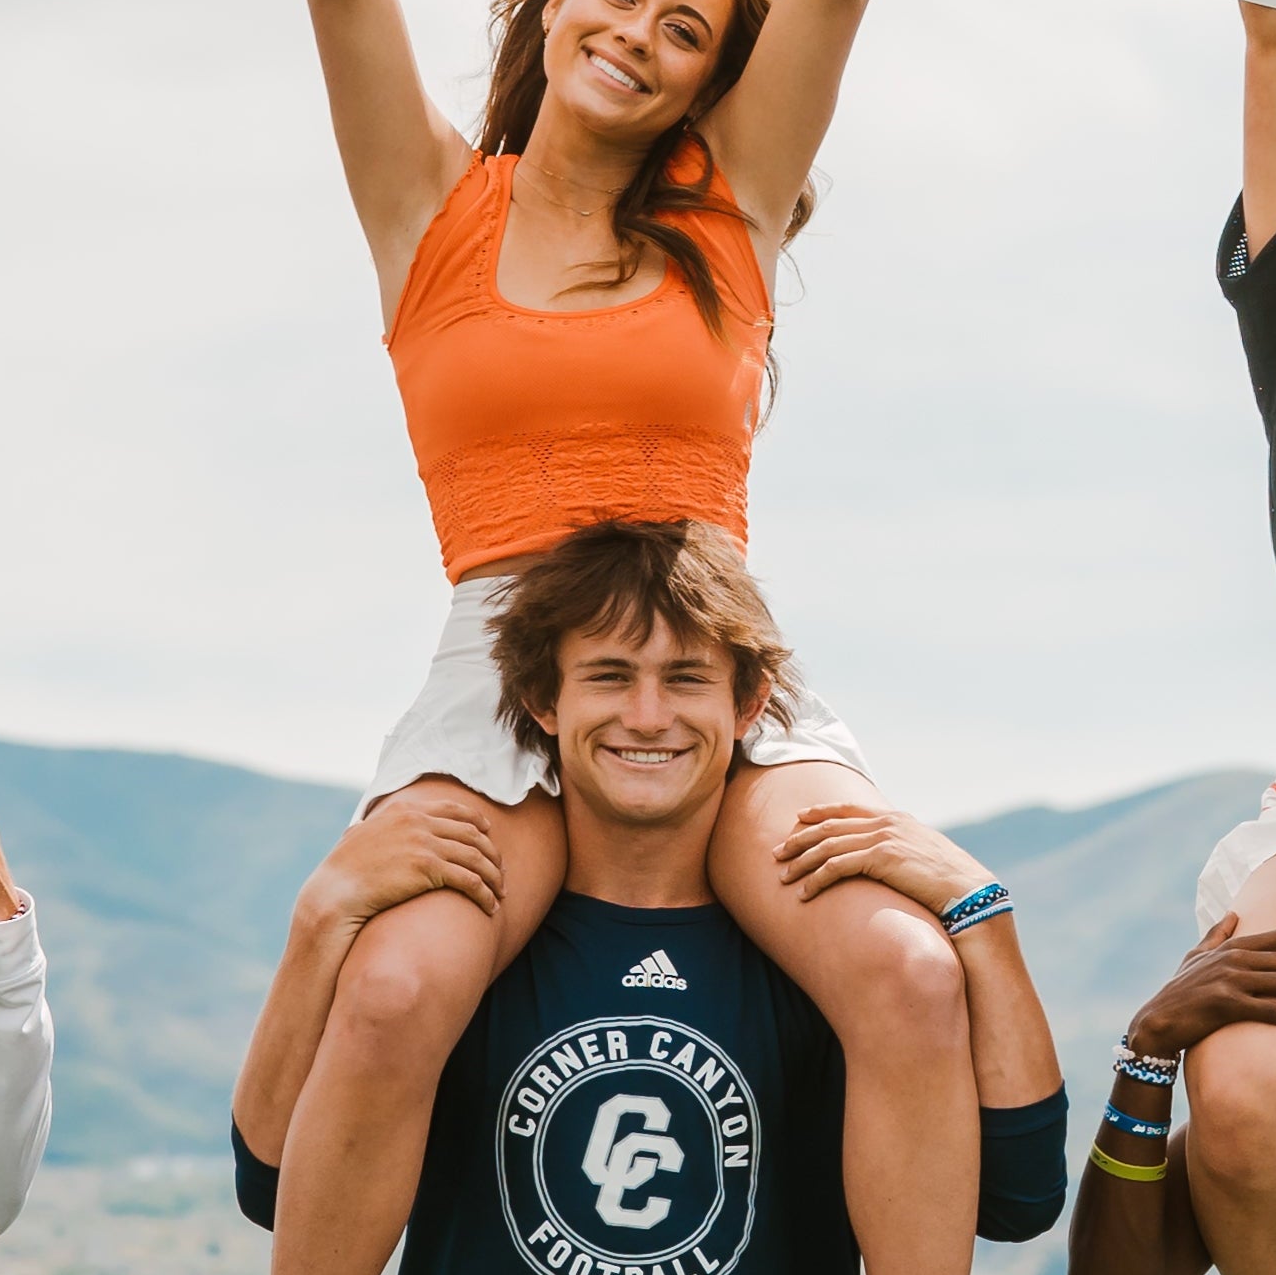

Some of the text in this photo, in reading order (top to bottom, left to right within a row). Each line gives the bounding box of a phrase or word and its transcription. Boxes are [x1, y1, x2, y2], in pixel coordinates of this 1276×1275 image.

[623, 972, 688, 991] adidas
[509, 1030, 750, 1168] CORNER CANYON
